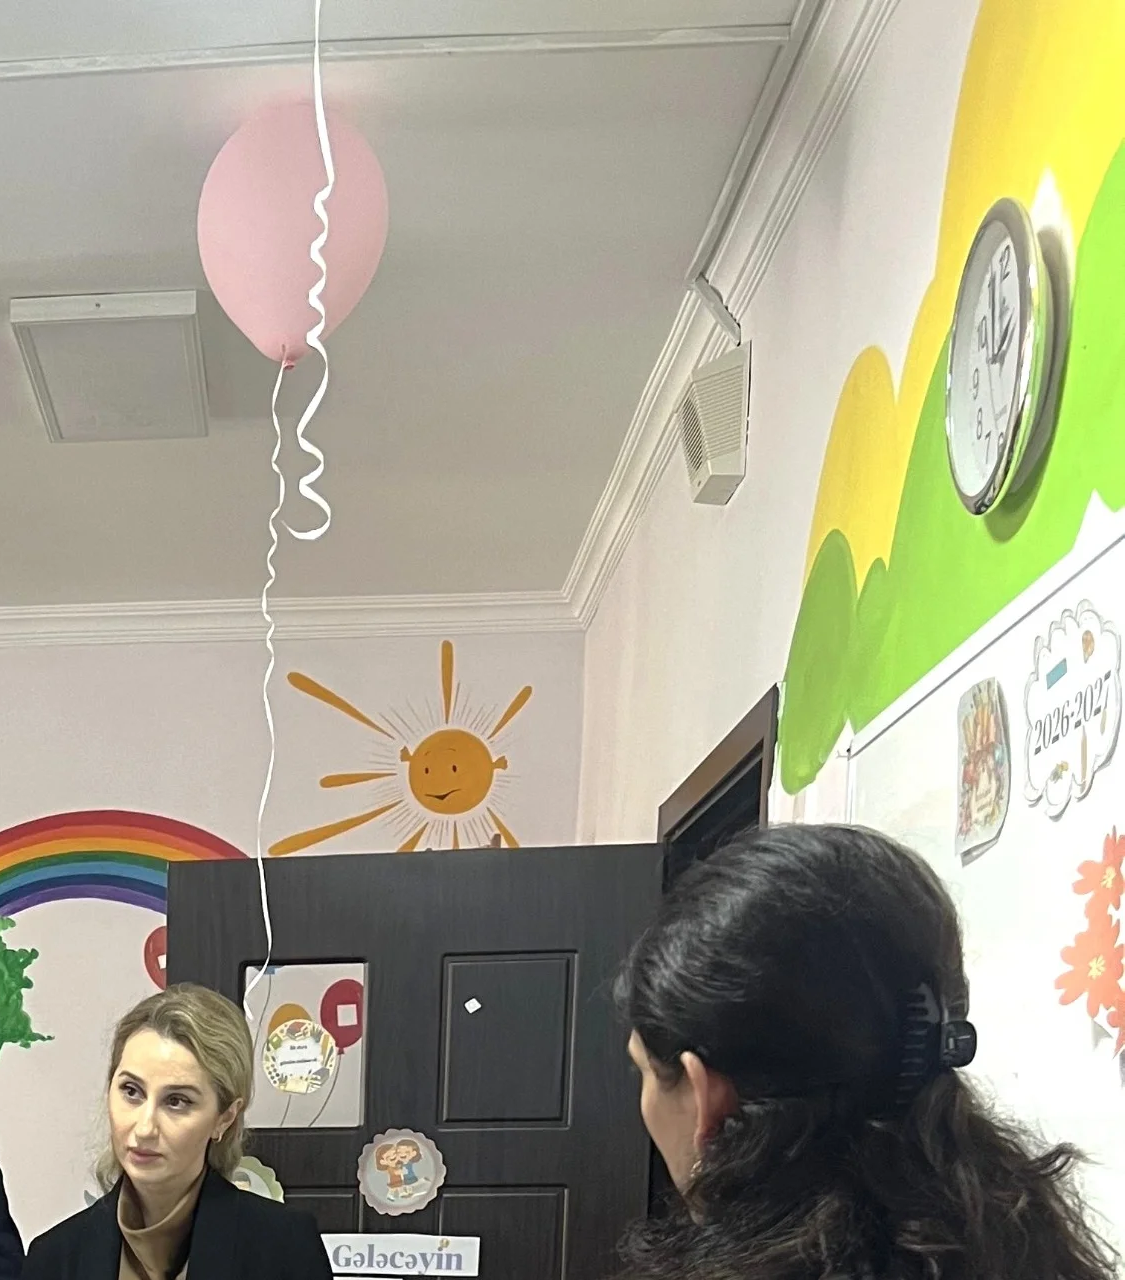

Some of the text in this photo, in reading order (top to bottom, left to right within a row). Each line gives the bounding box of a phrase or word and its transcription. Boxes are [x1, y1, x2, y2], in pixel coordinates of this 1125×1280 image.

[999, 244, 1010, 283] 12
[972, 367, 979, 400] 9
[976, 407, 983, 441] 8
[984, 430, 992, 465] 7
[1034, 670, 1112, 756] 2026-2027
[332, 1244, 463, 1275] Gələcəyin
